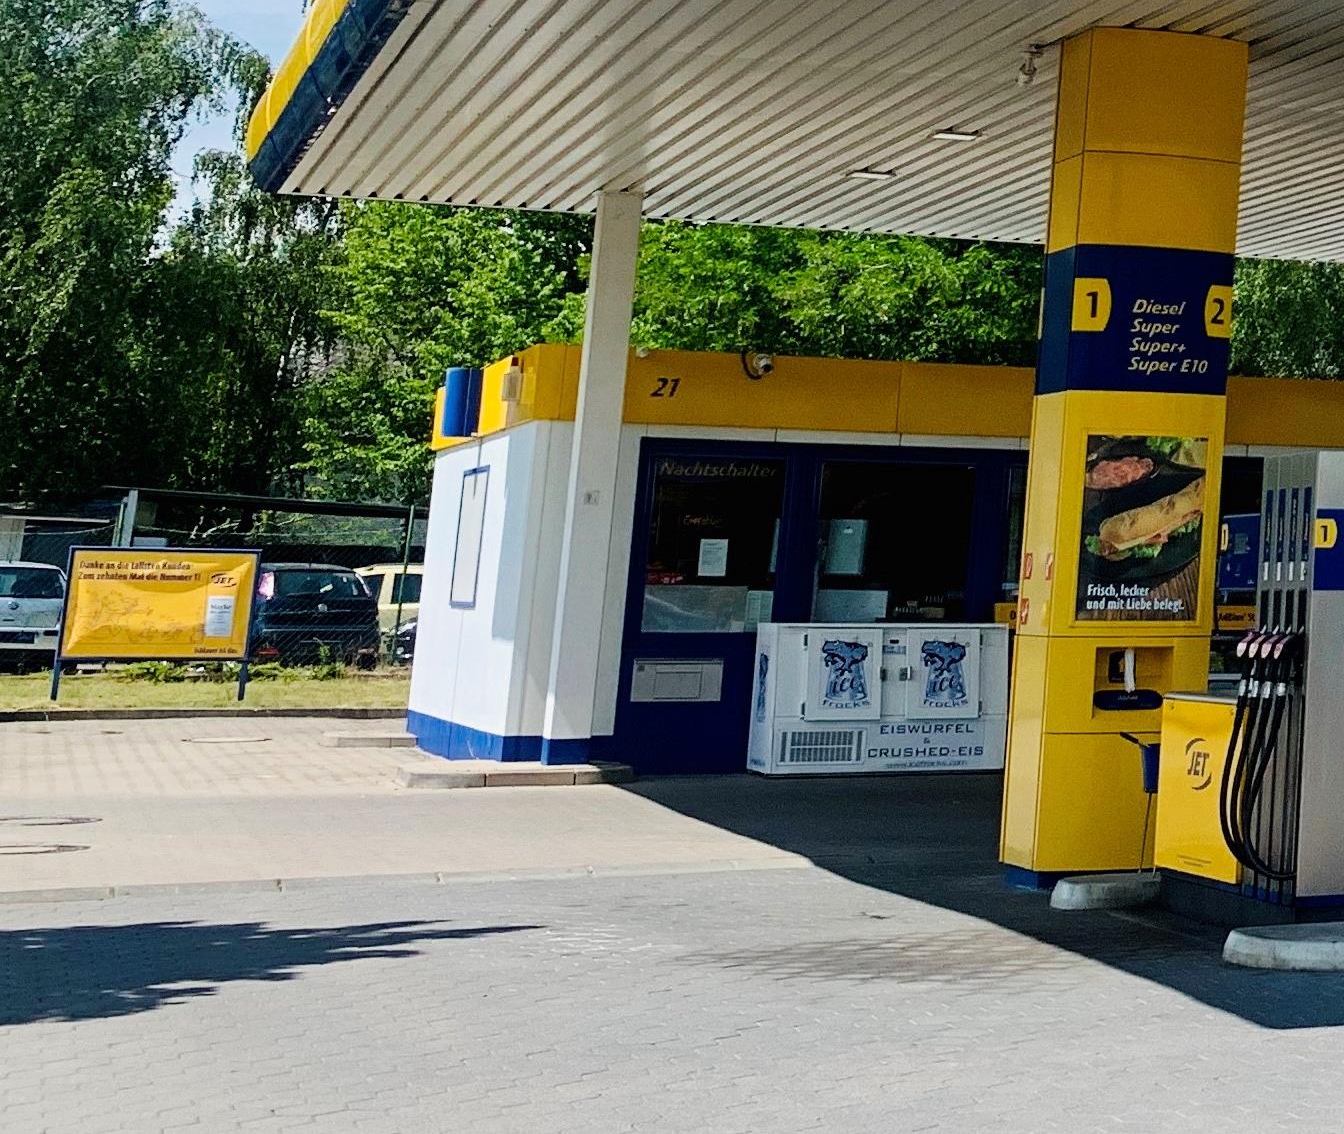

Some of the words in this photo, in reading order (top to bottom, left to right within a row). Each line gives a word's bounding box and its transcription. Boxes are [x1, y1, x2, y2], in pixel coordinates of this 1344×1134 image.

[1086, 291, 1098, 318] 1
[1132, 299, 1187, 315] Diesel
[1210, 297, 1224, 324] 2
[1130, 318, 1180, 337] Super
[1129, 337, 1186, 355] Super+
[1128, 357, 1177, 375] Super
[1180, 359, 1208, 373] E10
[650, 377, 681, 398] 21
[660, 461, 777, 478] Nachtschalter
[1320, 525, 1328, 542] 1
[1087, 583, 1118, 597] Frisch,
[1120, 583, 1149, 596] lecker
[1086, 597, 1105, 610] und
[1107, 597, 1124, 610] mit
[1126, 597, 1152, 610] Liebe
[1153, 597, 1184, 612] belegt.
[822, 699, 870, 709] frocks
[923, 698, 969, 708] frocks
[880, 721, 975, 735] EISWÜRFEL
[867, 746, 984, 758] CRUSHED-EIS
[1187, 751, 1210, 777] JET
